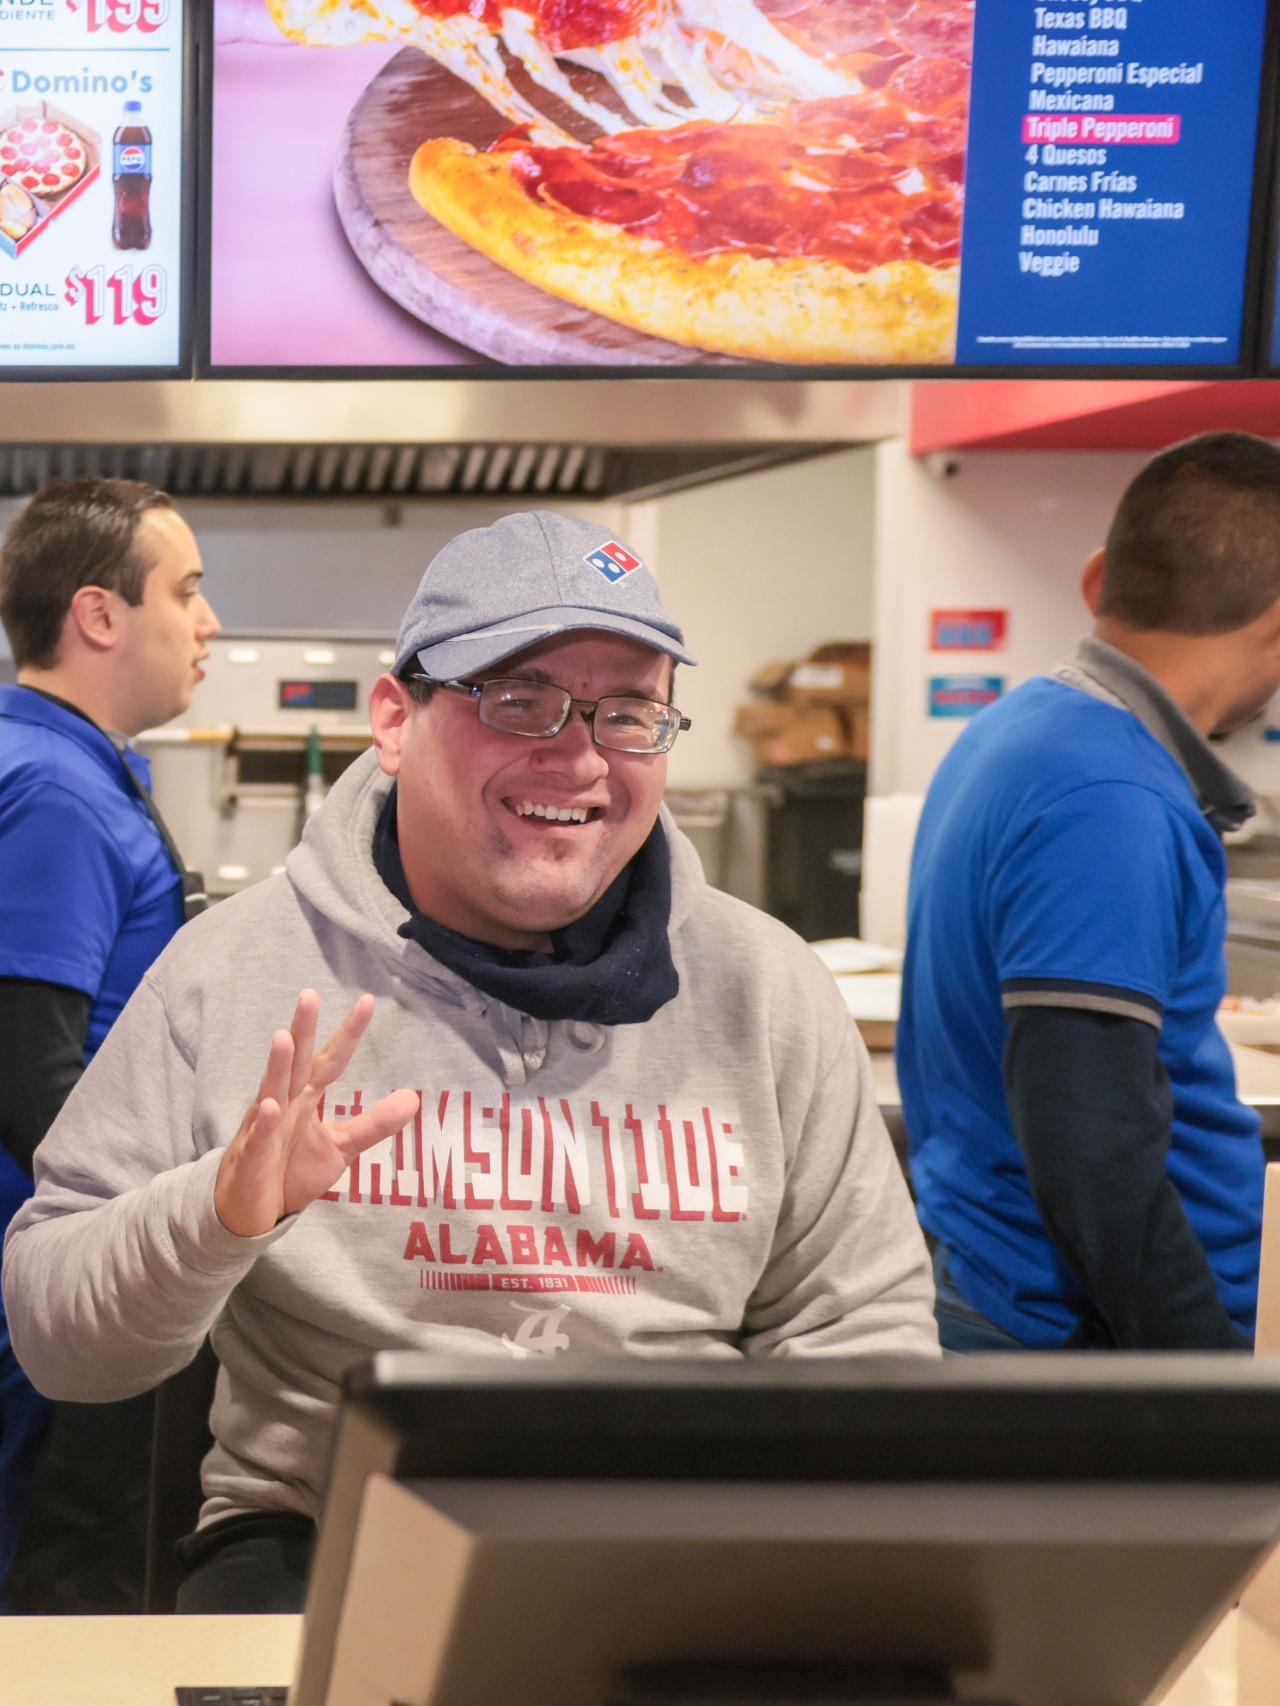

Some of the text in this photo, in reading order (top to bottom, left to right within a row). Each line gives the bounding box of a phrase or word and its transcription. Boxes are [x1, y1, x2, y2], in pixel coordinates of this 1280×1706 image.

[1034, 7, 1128, 30] Texas BBQ
[1032, 35, 1120, 57] Hawaiana
[13, 67, 153, 93] Domino's
[1030, 62, 1204, 88] Pepperoni Especial
[1028, 90, 1115, 112] Mexicana
[1027, 117, 1175, 142] Triple Pepperoni
[1024, 144, 1108, 166] 4 Quesos
[1023, 170, 1088, 193] Carnes
[1022, 197, 1185, 220] Chicken Hawaiana
[1020, 224, 1100, 246] Honolulu
[1018, 251, 1081, 277] Veggie
[64, 264, 168, 325] $119
[20, 301, 59, 312] Refresco
[403, 1221, 655, 1272] ALABAMA
[501, 1277, 569, 1289] EST. 1831
